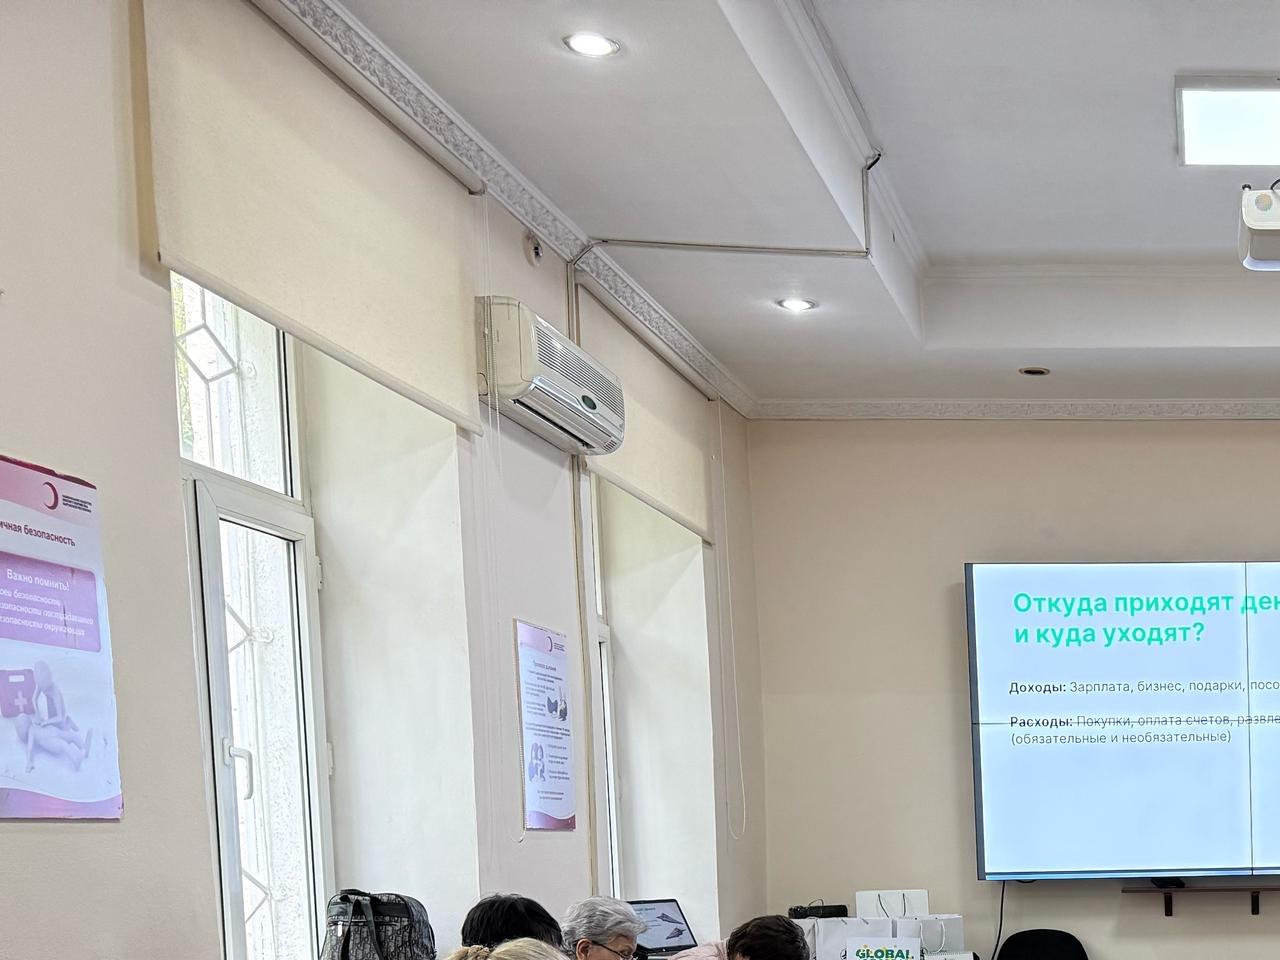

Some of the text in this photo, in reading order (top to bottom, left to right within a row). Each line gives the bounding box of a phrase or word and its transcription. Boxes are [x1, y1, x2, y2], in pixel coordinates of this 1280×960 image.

[24, 524, 76, 547] безопасность
[7, 568, 70, 592] Важно помнить!
[1013, 592, 1107, 617] Откуда
[1114, 594, 1234, 617] приходят
[1014, 622, 1205, 648] и куда уходят?
[1009, 682, 1067, 695] Доходы:
[1069, 681, 1134, 694] Зарплата,
[1137, 680, 1185, 693] бизнес,
[1189, 680, 1245, 693] подарки,
[1010, 716, 1073, 728] Расходы:
[1077, 715, 1134, 729] Покупки,
[1138, 716, 1182, 726] оплата
[1186, 715, 1233, 727] счетов,
[1011, 730, 1231, 746] (обязательные и необязательные)
[856, 948, 911, 960] GLOBAL
